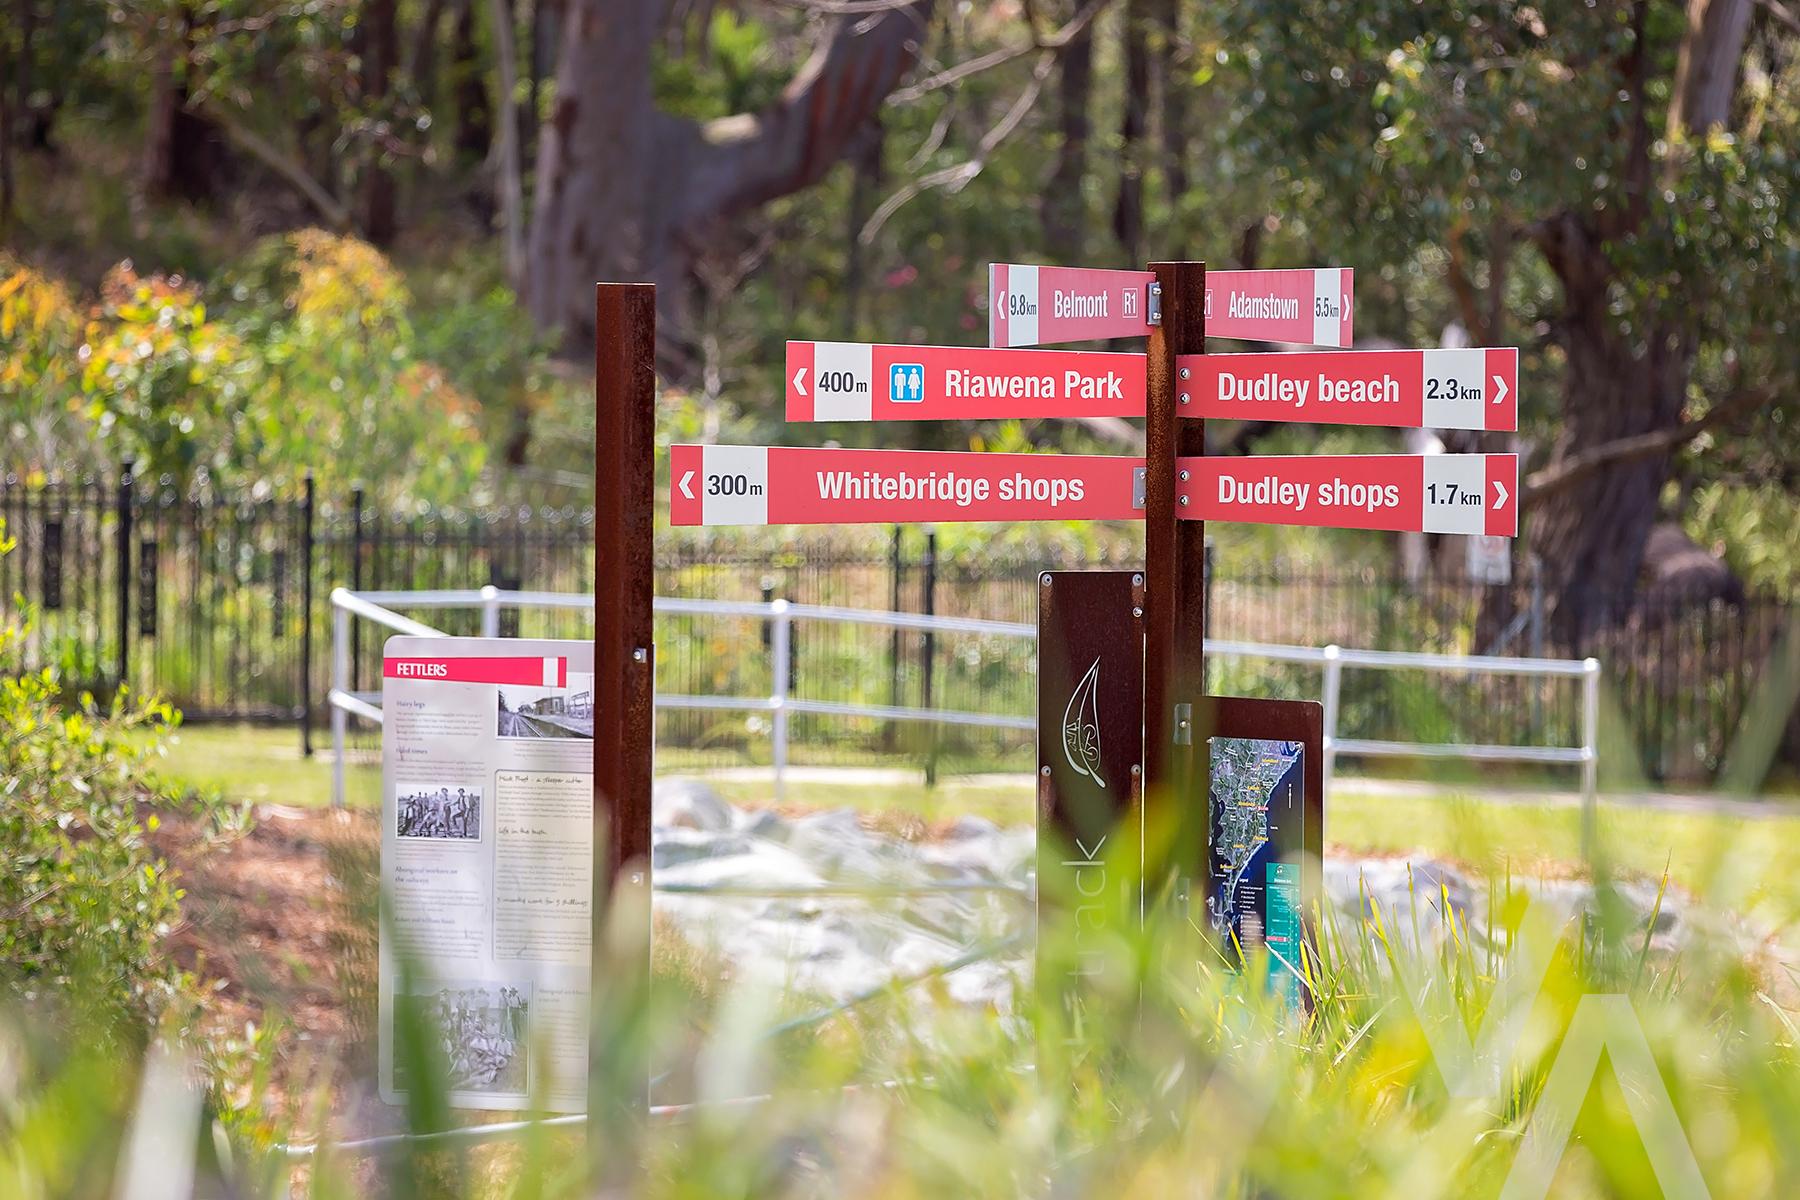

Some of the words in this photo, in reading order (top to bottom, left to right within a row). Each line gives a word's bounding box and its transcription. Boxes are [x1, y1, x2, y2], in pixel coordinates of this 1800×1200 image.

[1054, 289, 1109, 320] Belmont
[1124, 291, 1138, 315] R1
[1228, 290, 1299, 320] Adamstown
[945, 369, 1055, 399] Riawena
[1064, 371, 1124, 400] Park
[1218, 372, 1310, 407] Dudley
[1318, 373, 1399, 403] beach
[817, 471, 990, 506] Whitebridge
[999, 472, 1085, 506] shops
[1218, 475, 1310, 511] Dudley
[1318, 478, 1399, 512] shops
[396, 661, 448, 677] FETTLERS
